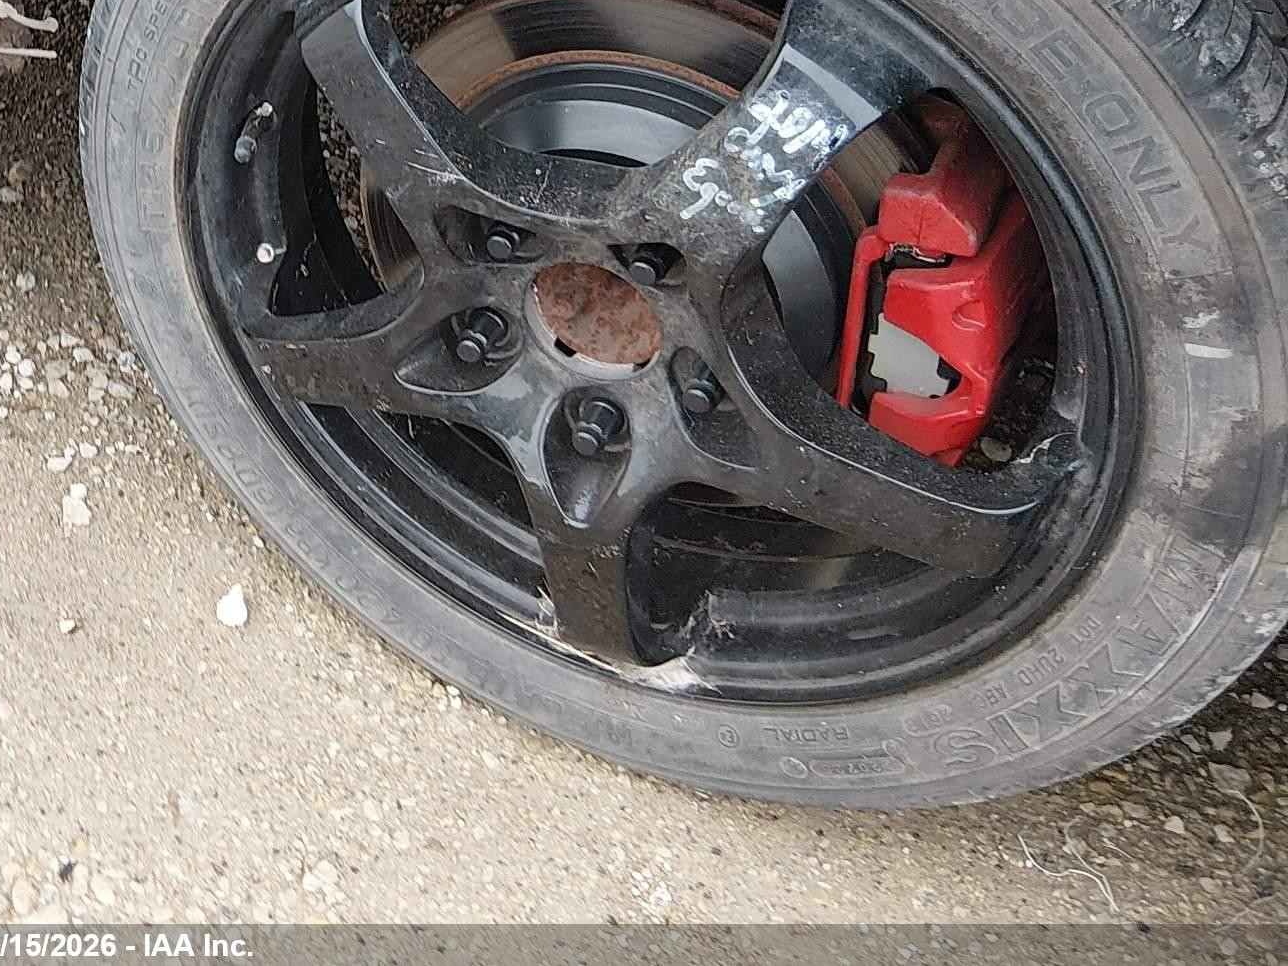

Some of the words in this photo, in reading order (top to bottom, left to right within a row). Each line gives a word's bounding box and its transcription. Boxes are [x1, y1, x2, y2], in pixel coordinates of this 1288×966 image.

[123, 45, 149, 92] TPC
[1074, 88, 1216, 255] ONLY
[926, 530, 1226, 772] MAXXIS
[1066, 613, 1101, 647] DOT
[762, 726, 850, 740] RADIAL
